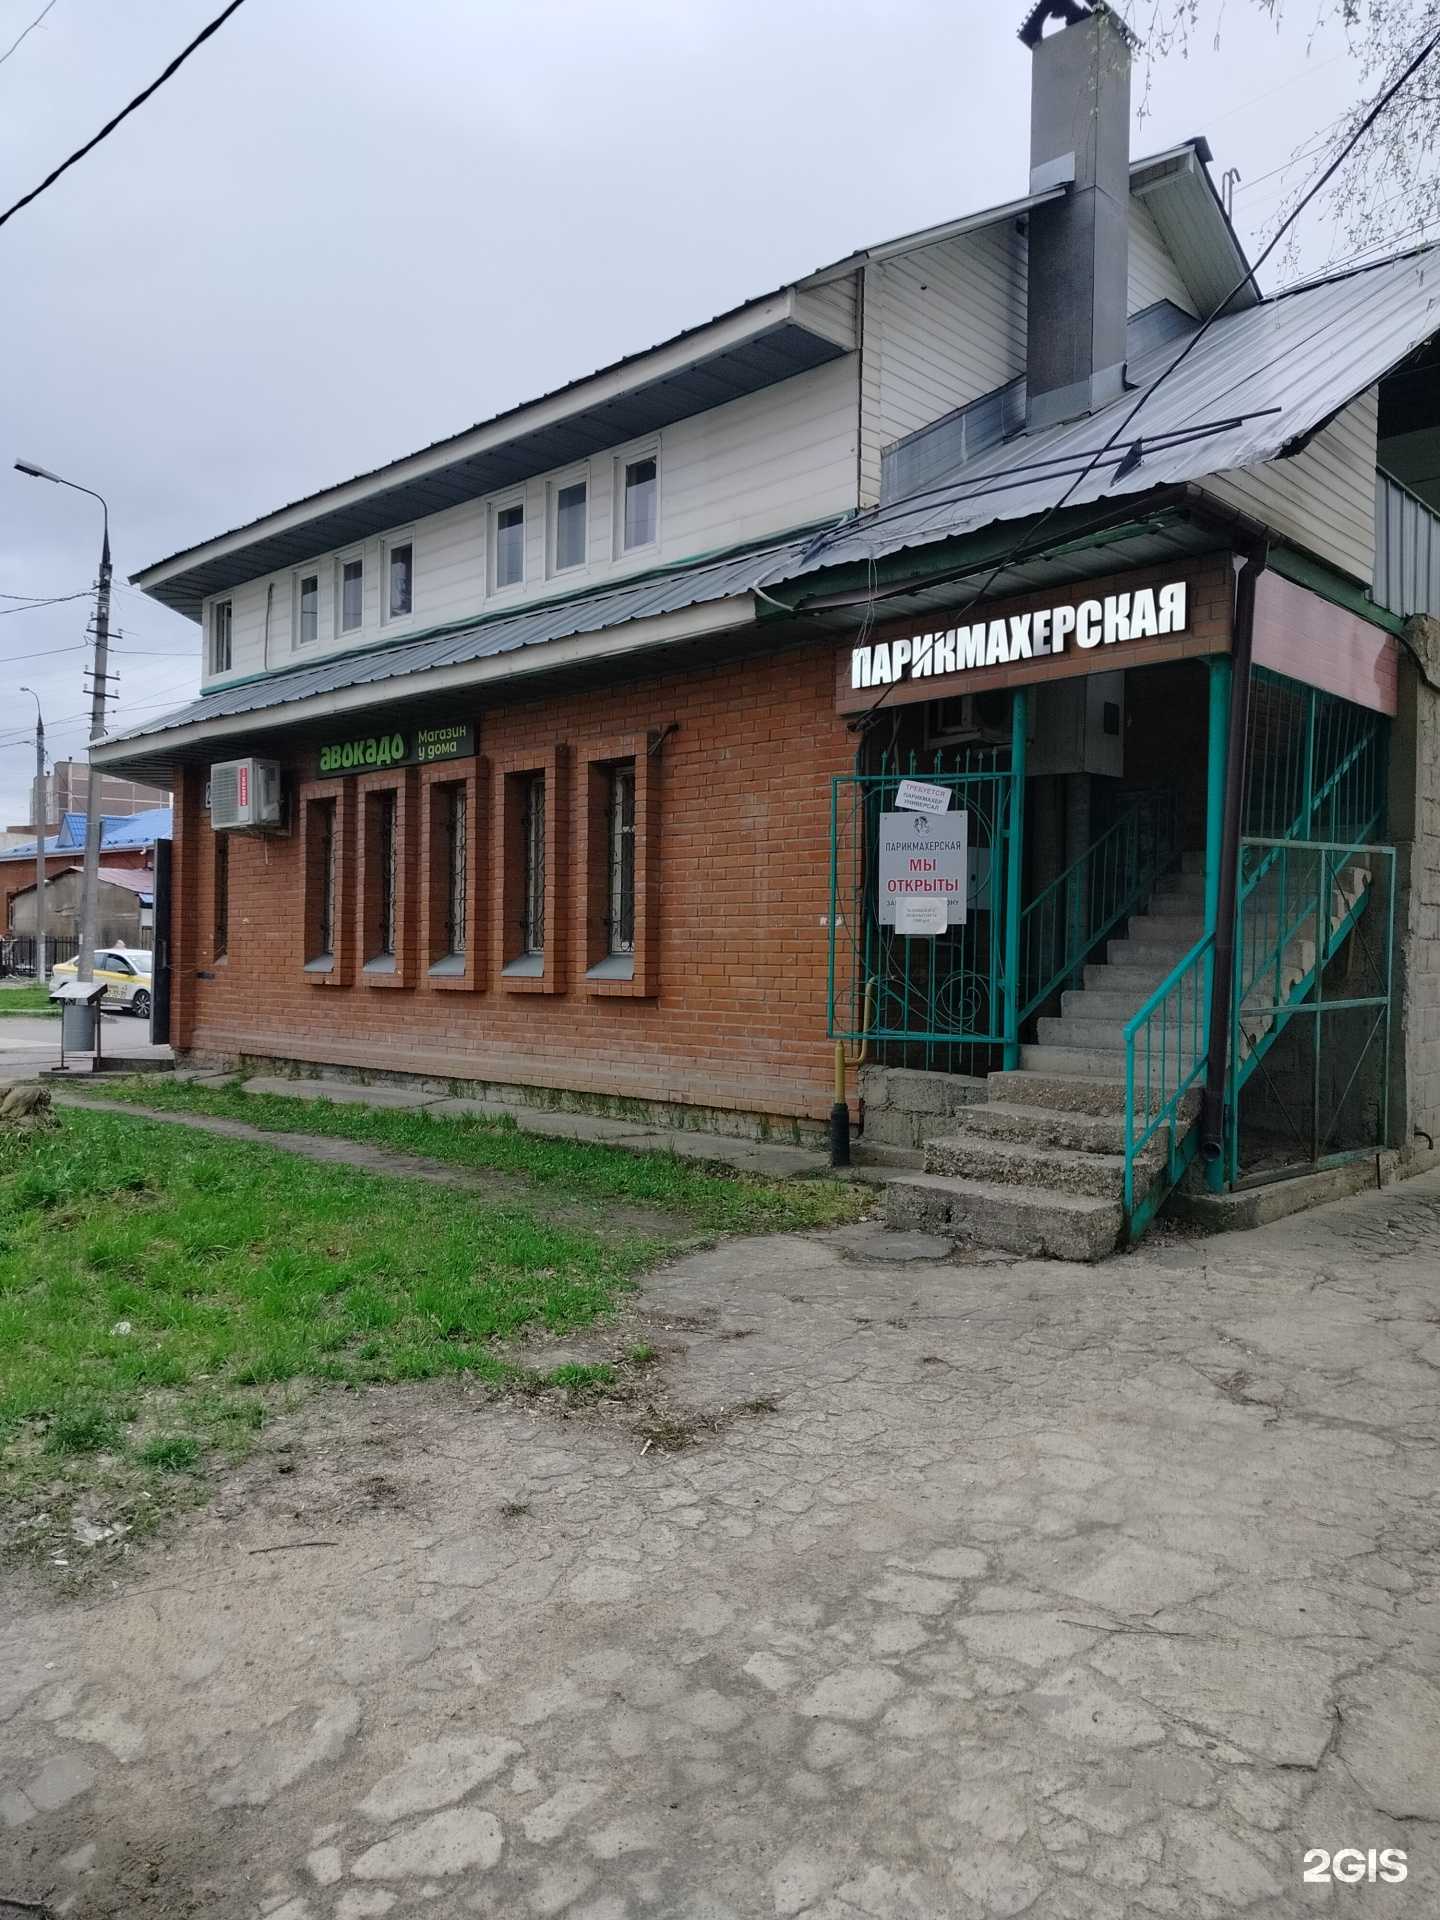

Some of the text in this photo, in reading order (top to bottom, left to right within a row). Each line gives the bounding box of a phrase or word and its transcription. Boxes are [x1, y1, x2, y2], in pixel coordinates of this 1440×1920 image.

[851, 581, 1187, 689] ПАРИКМАХЕРСКАЯ
[418, 725, 467, 744] Магазин
[418, 740, 457, 760] у дома
[905, 783, 946, 798] ТРЕБУЕТСЯ
[885, 840, 961, 852] ПАРИКМАХЕРСКАЯ
[909, 858, 937, 872] МЫ
[887, 879, 959, 893] ОТКРЫТЫ
